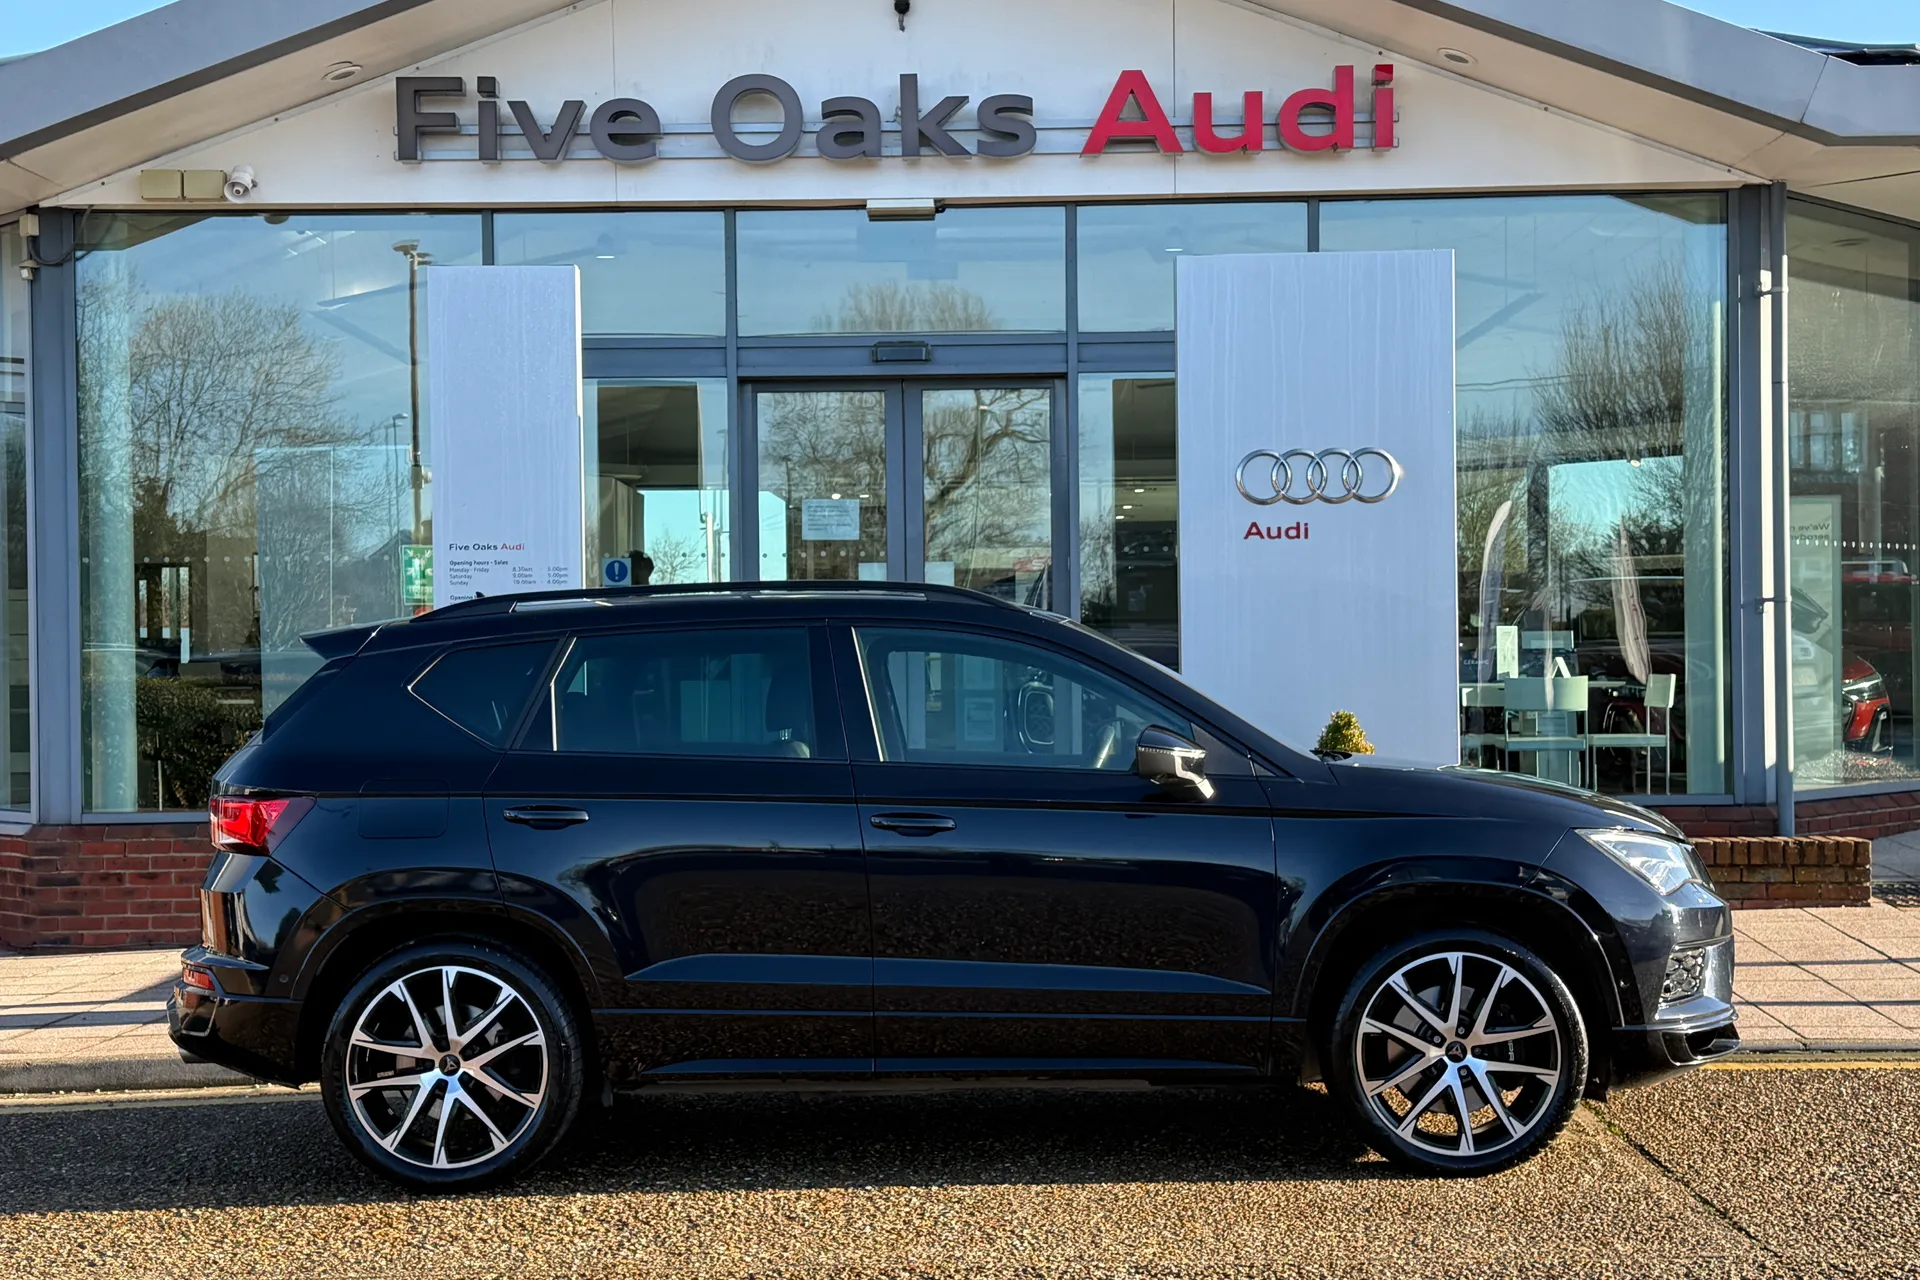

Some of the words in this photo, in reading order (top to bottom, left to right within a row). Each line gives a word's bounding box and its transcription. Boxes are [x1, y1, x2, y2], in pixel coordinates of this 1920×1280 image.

[396, 75, 661, 163] Five
[711, 73, 1037, 163] Oaks
[1080, 64, 1394, 156] Audi
[1243, 521, 1309, 540] Audi
[449, 543, 470, 551] Five
[472, 543, 498, 551] Oaks
[501, 543, 525, 551] Audi
